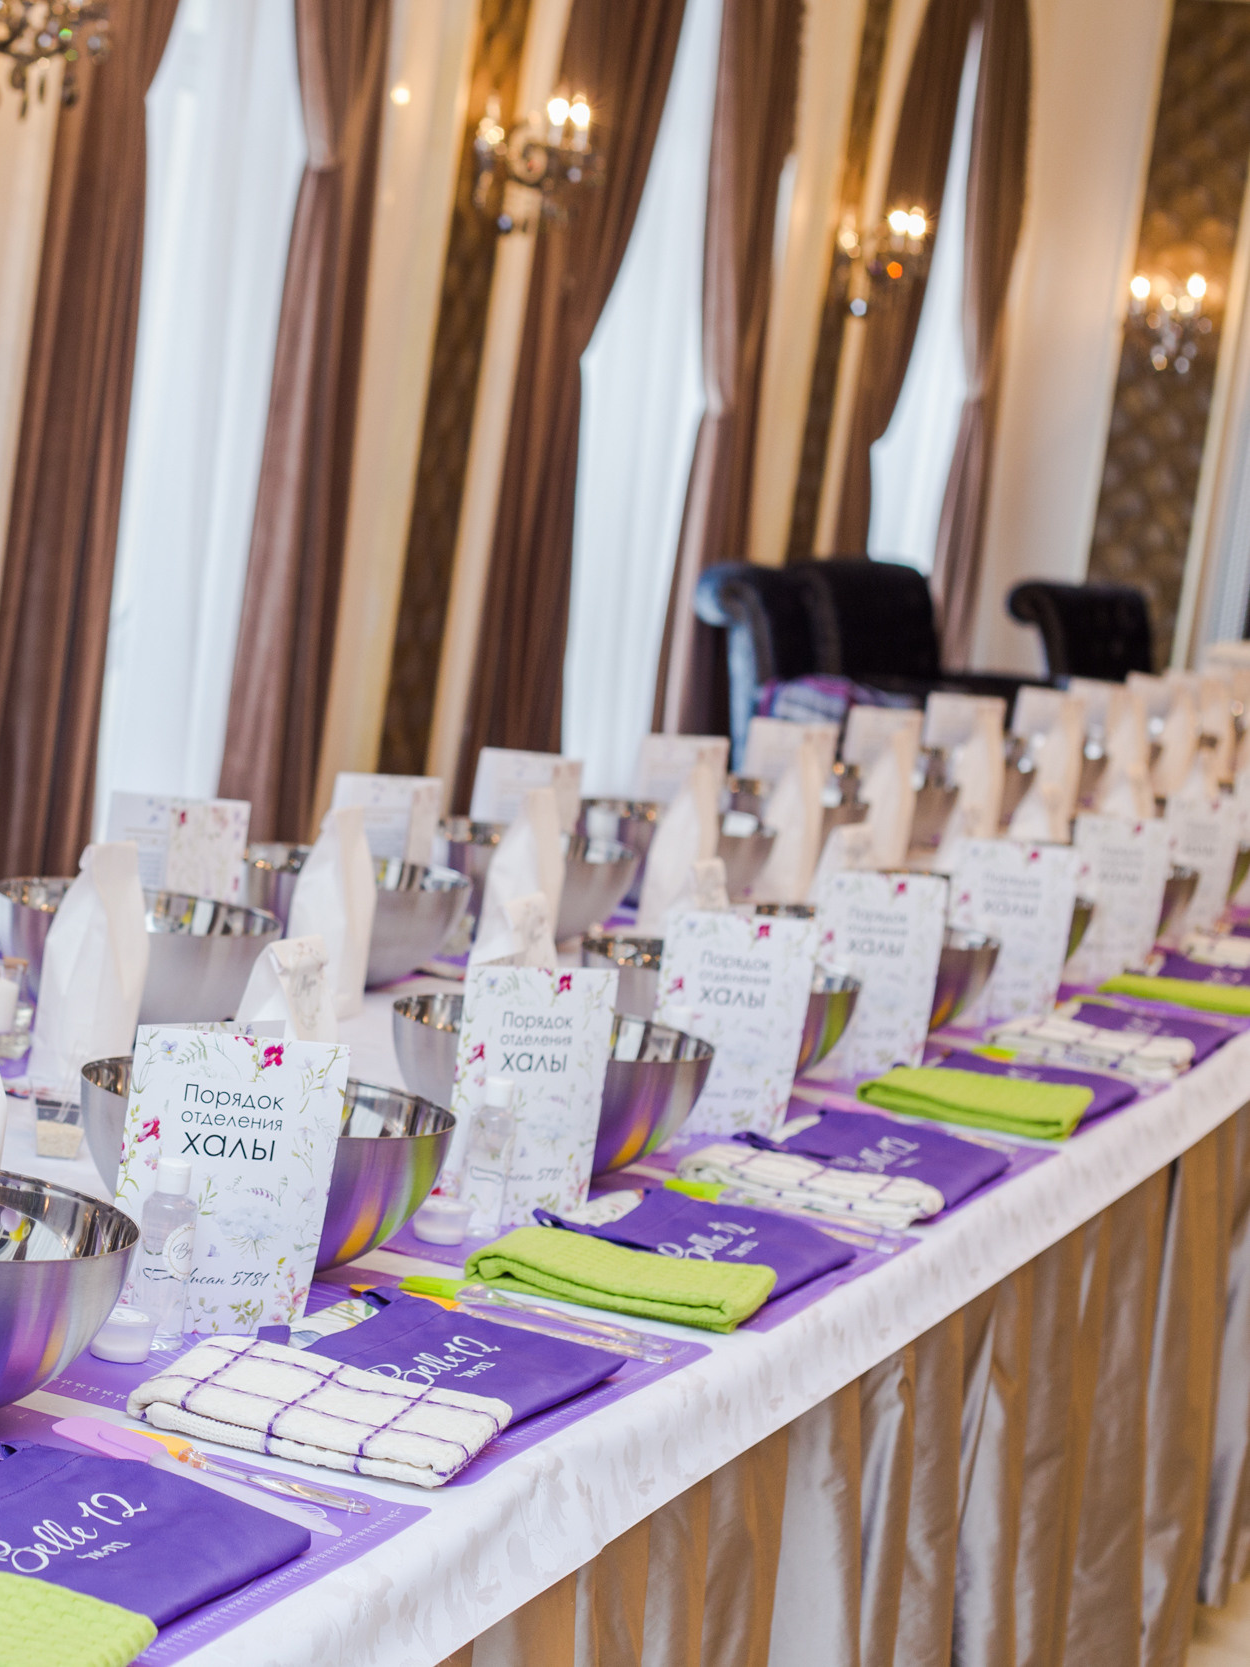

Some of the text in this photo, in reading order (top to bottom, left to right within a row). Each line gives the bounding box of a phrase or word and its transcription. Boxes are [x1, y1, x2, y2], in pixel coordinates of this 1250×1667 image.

[698, 986, 766, 1008] халы
[502, 1011, 573, 1031] Порядок
[499, 1034, 572, 1046] отделения
[500, 1052, 568, 1073] халы
[184, 1083, 284, 1111] Порядок
[181, 1111, 283, 1131] отделения
[181, 1131, 275, 1162] халы
[231, 1271, 270, 1287] 5781
[366, 1335, 502, 1387] Belle 12
[77, 1493, 148, 1526] 12
